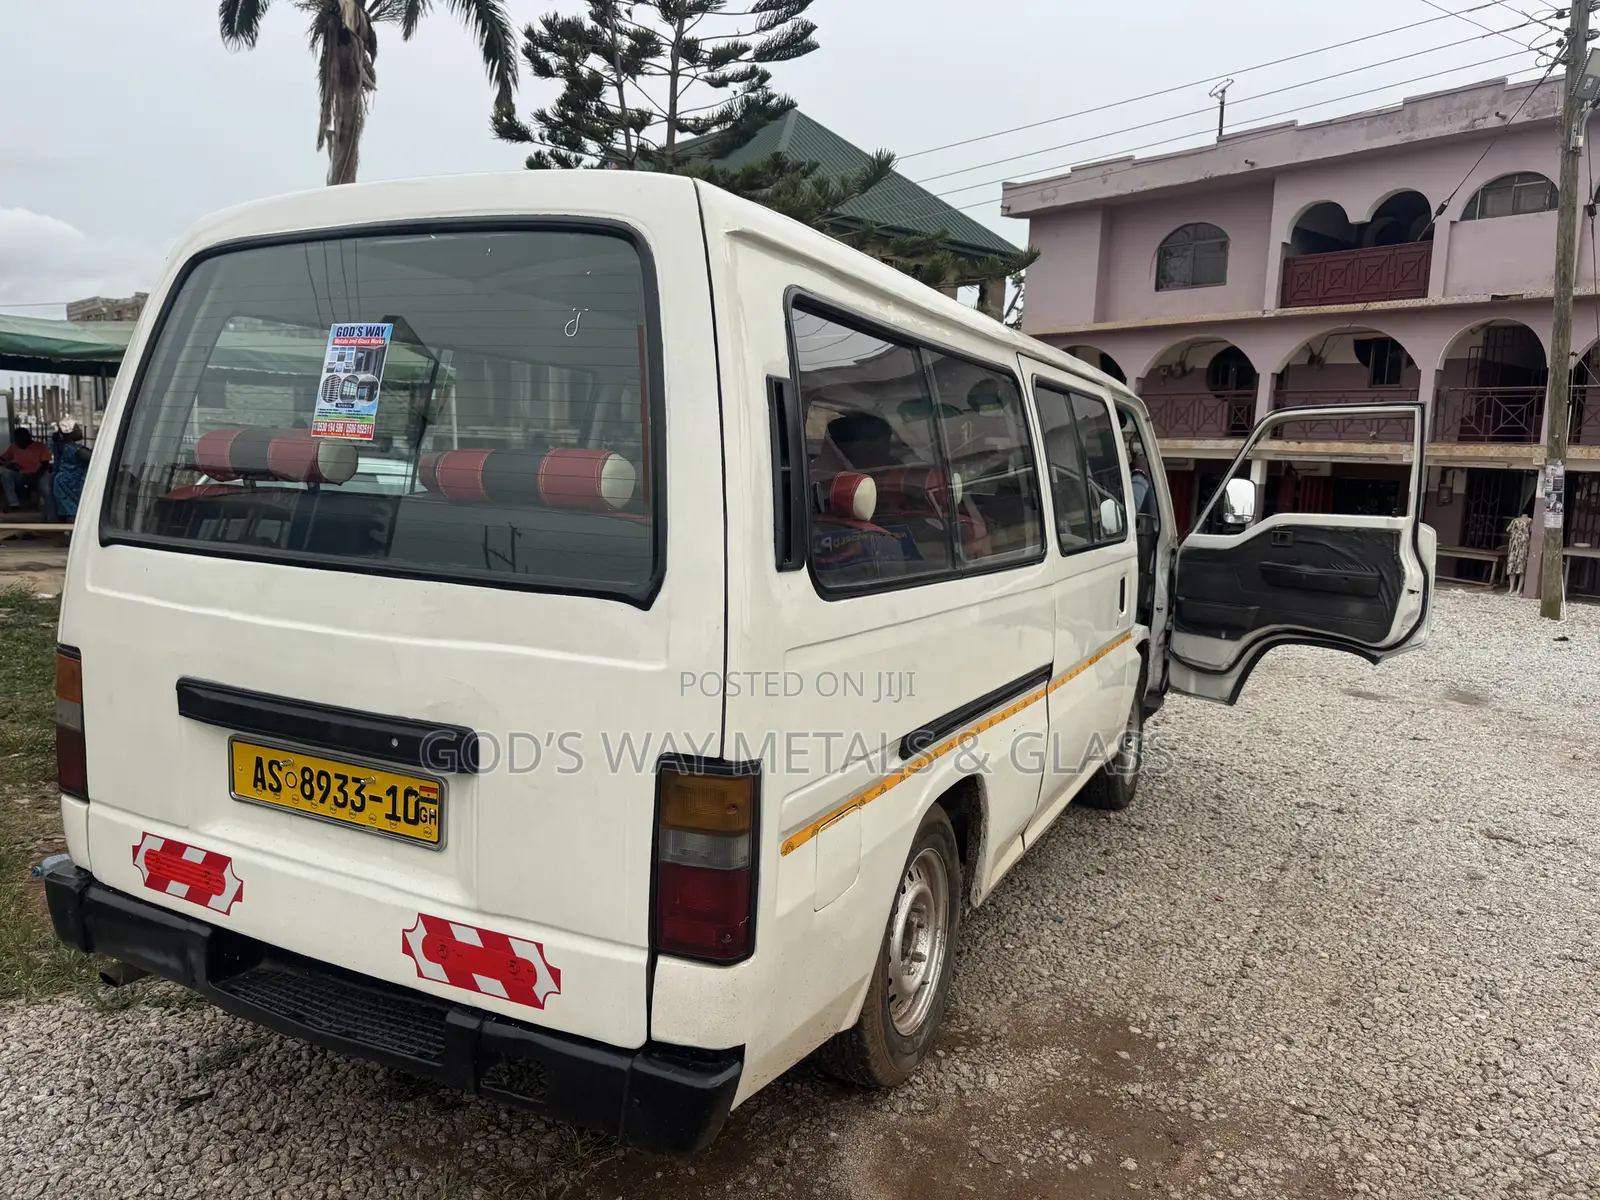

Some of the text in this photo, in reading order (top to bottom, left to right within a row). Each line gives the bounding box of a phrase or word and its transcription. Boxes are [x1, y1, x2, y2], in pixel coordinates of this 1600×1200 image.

[336, 326, 386, 337] GOD'S WAY
[253, 756, 438, 826] AS 8933-10 GH
